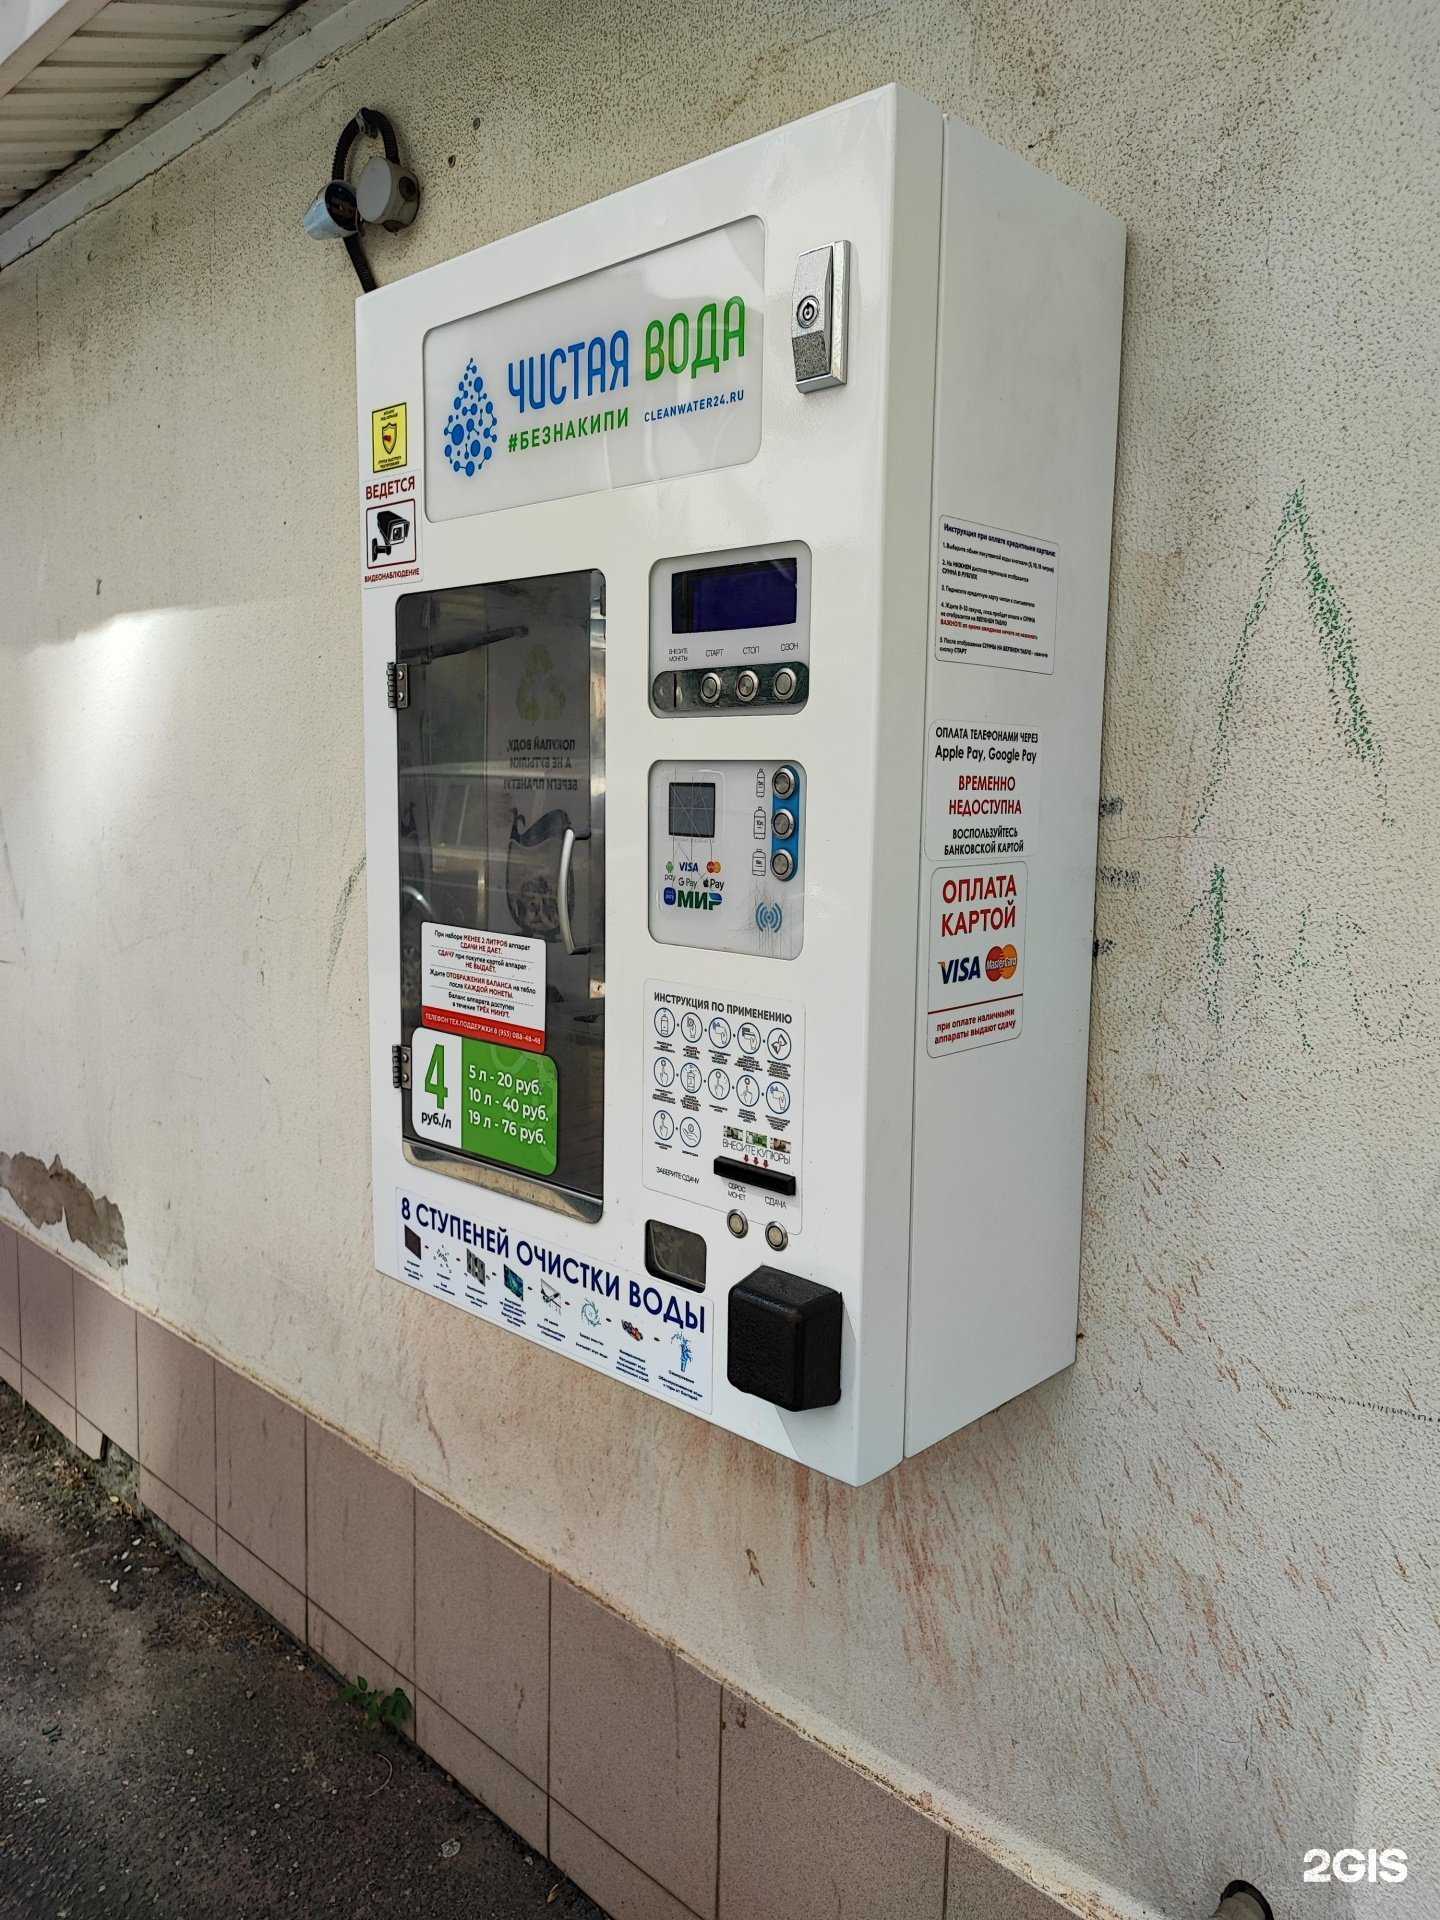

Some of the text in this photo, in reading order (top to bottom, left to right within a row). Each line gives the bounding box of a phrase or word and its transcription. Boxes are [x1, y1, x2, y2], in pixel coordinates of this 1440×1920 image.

[508, 296, 744, 414] ЧИСТАЯ ВОДА
[644, 390, 744, 422] CLEANWATER24.RU
[508, 407, 628, 453] #БЕЗНАКИПИ
[366, 476, 415, 500] ВЕДЕТСЯ
[944, 523, 976, 537] Инструкция
[364, 568, 419, 582] ВИДЕОНАБЛЮДЕНИЕ
[706, 649, 723, 657] СТАРТ
[743, 645, 759, 655] СТОП
[781, 642, 799, 651] ОЗОН
[936, 727, 1038, 743] ОПЛАТА ТЕЛЕФОНАМИ ЧЕРЕЗ
[935, 745, 1036, 764] Apple Pay, Google Pay
[959, 775, 1015, 791] ВРЕМЕННО
[949, 800, 1021, 816] НЕДОСТУПНА
[953, 826, 1018, 839] ВОСПОЛЬЗУЙТЕСЬ
[945, 840, 1023, 855] БАНКОВСКОЙ КАРТОЙ
[679, 862, 698, 872] VISA
[686, 879, 697, 889] Pay
[710, 879, 724, 891] Pay
[943, 875, 1016, 903] ОПЛАТА
[677, 890, 722, 910] МИР
[942, 900, 1015, 937] КАРТОЙ
[464, 935, 480, 943] МЕНЕЕ
[486, 938, 507, 947] ЛИТРОВ
[938, 956, 980, 984] VISA
[987, 957, 1016, 969] MasterCard
[654, 992, 792, 1024] ИНСТРУКЦИЯ ПО ПРИМЕНЕНИЮ
[937, 1009, 1014, 1033] при оплате наличными
[935, 1020, 1016, 1044] аппараты выдают сдачу
[425, 1044, 448, 1110] 4
[469, 1064, 476, 1078] 5
[479, 1070, 486, 1081] л
[498, 1072, 512, 1087] 20
[516, 1078, 542, 1095] руб.
[469, 1087, 481, 1102] 10
[484, 1094, 492, 1106] л
[503, 1096, 518, 1112] 40
[522, 1104, 548, 1121] руб.
[422, 1111, 451, 1129] руб./л
[469, 1110, 480, 1125] 19
[483, 1117, 491, 1128] л
[502, 1119, 516, 1135] 76
[520, 1127, 546, 1145] руб.
[728, 1183, 746, 1192] СБРОС
[728, 1191, 745, 1200] МОНЕТ
[765, 1196, 786, 1208] СДАЧА
[402, 1197, 410, 1220] 8
[416, 1203, 509, 1258] СТУПЕНЕЙ
[517, 1240, 620, 1301] ОЧИСТКИ
[629, 1280, 705, 1333] ВОДЫ
